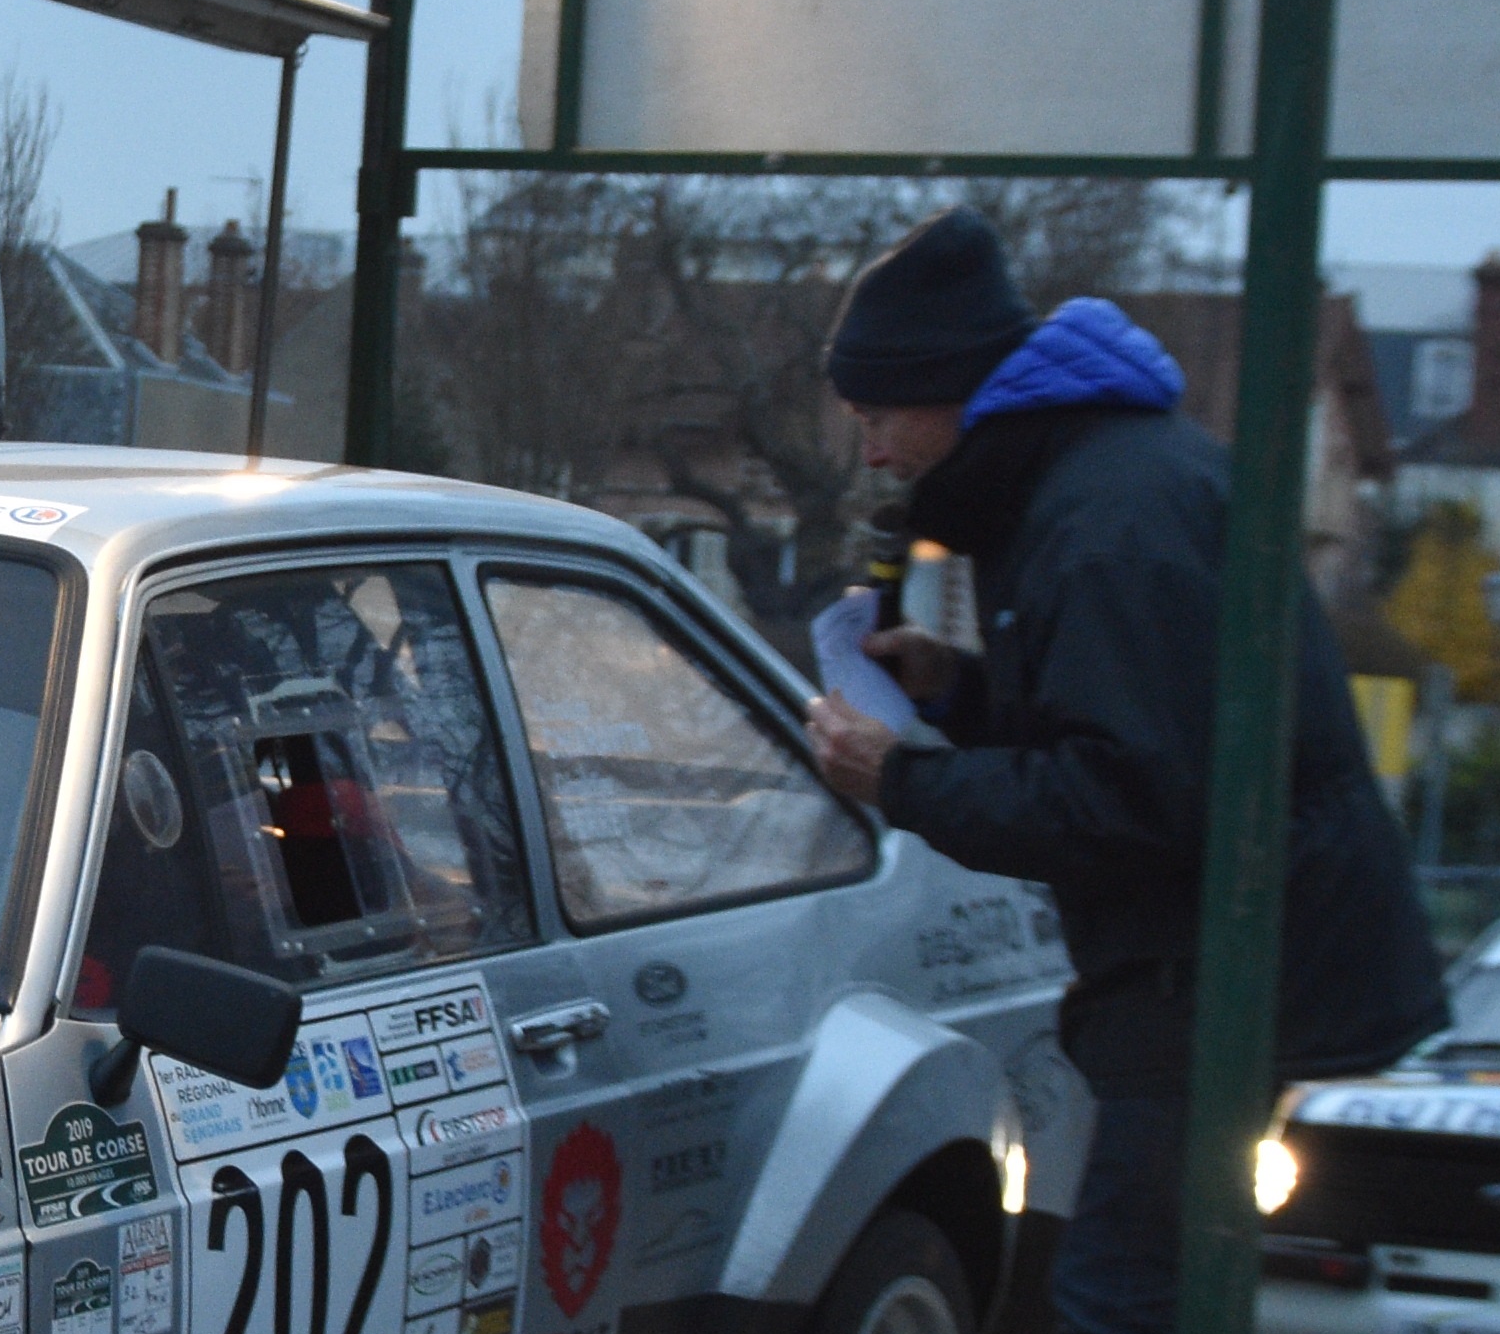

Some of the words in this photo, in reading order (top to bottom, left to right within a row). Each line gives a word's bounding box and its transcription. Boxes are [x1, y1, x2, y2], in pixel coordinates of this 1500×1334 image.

[414, 998, 478, 1035] FFSA
[65, 1116, 95, 1144] 2019
[23, 1150, 70, 1178] TOUR
[71, 1144, 94, 1169] DE
[95, 1131, 147, 1162] CORSE
